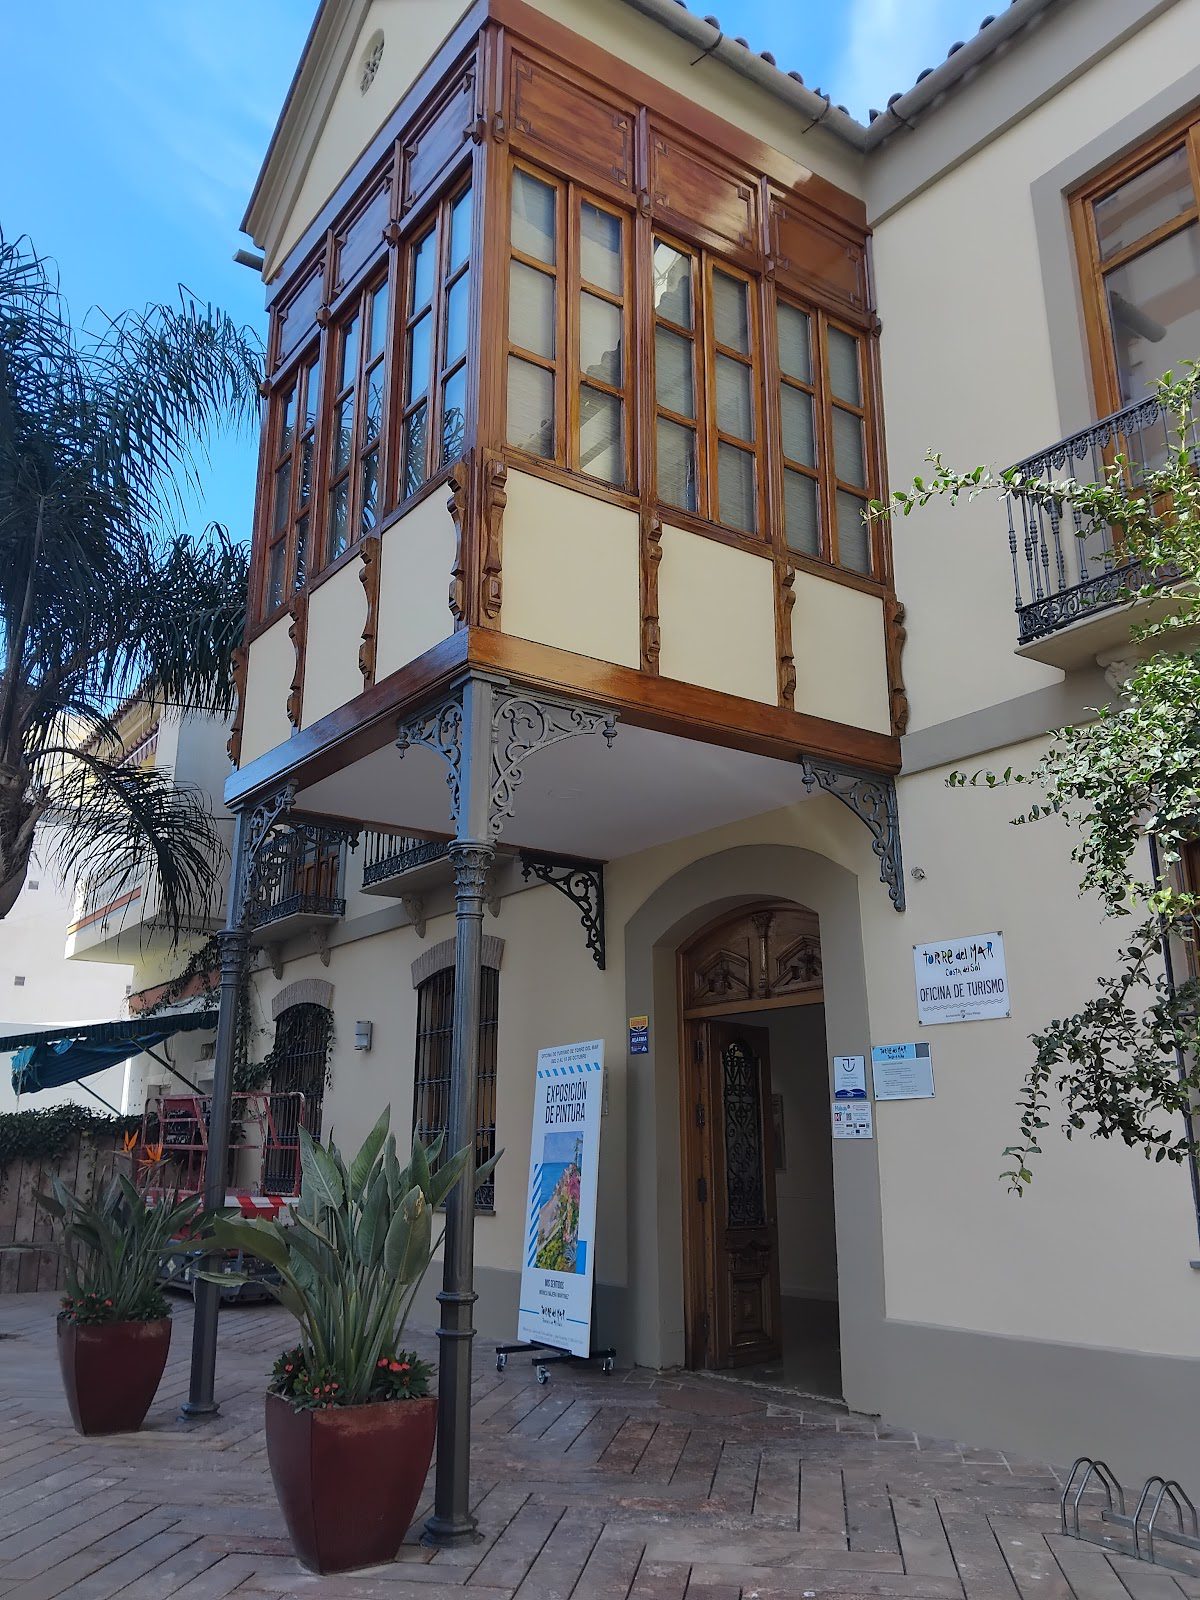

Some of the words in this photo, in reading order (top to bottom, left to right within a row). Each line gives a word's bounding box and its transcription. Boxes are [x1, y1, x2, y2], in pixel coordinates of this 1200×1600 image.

[956, 947, 968, 961] del
[970, 941, 994, 965] MAR
[970, 963, 981, 973] Sol
[920, 984, 952, 1002] OFICINA
[953, 983, 965, 998] DE
[967, 978, 1005, 997] TURISMO
[546, 1078, 588, 1104] EXPOSICIÓN
[545, 1105, 555, 1124] DE
[555, 1102, 586, 1123] PINTURA
